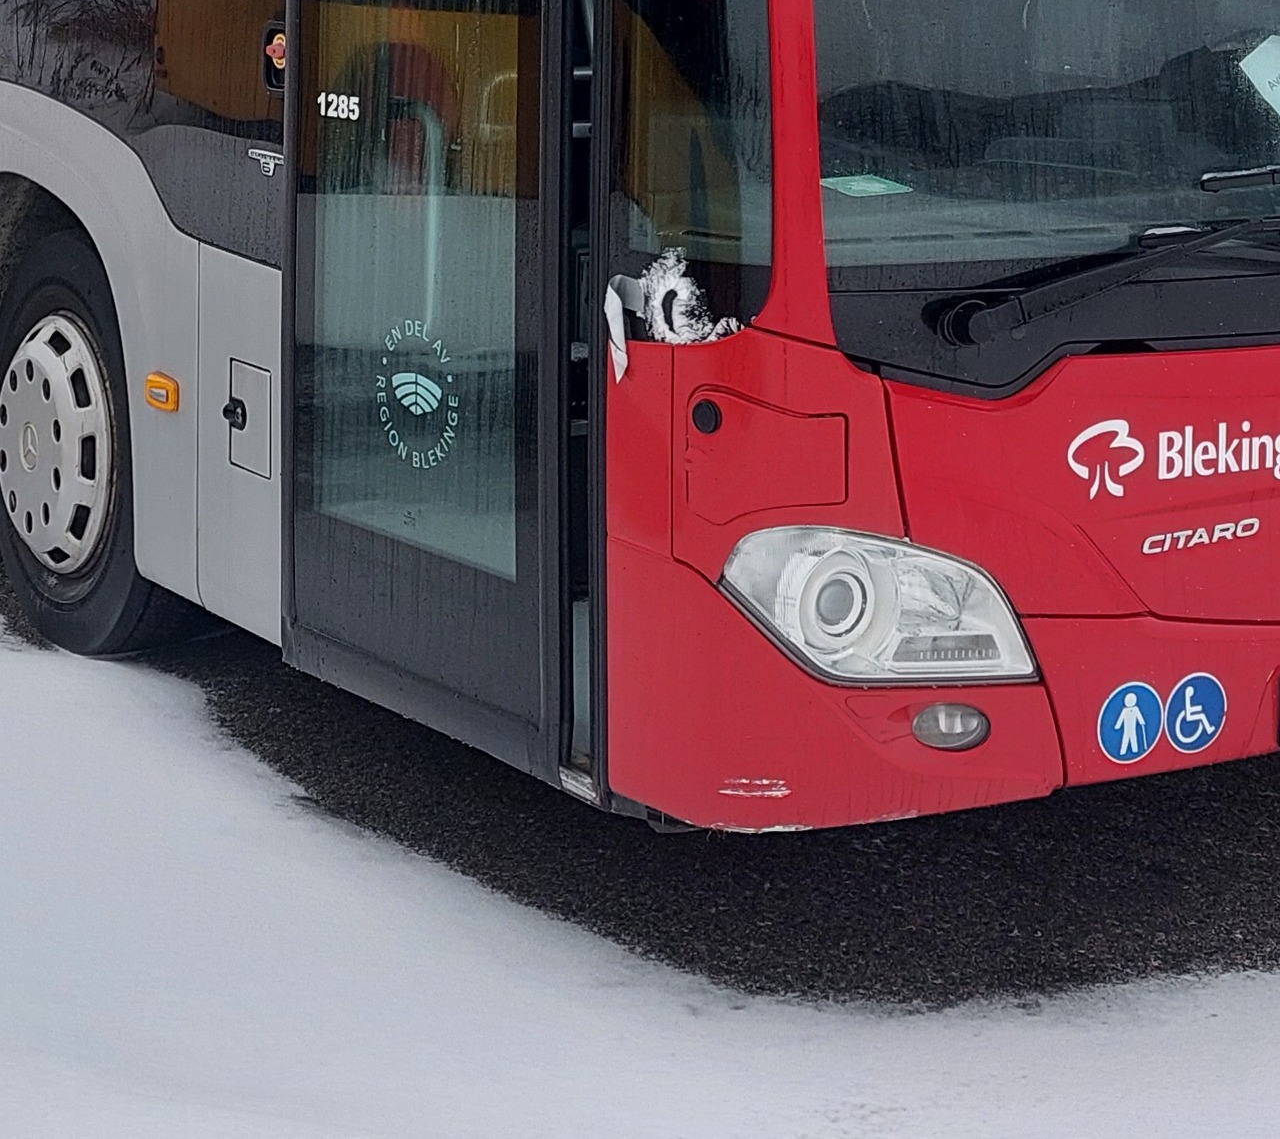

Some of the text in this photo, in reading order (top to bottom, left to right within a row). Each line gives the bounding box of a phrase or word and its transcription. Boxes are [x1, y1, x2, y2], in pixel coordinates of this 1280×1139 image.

[317, 92, 360, 121] 1285
[384, 320, 450, 364] EN DEL AV
[376, 375, 459, 469] REGION BLEKINGE
[1142, 518, 1260, 554] CITARO
